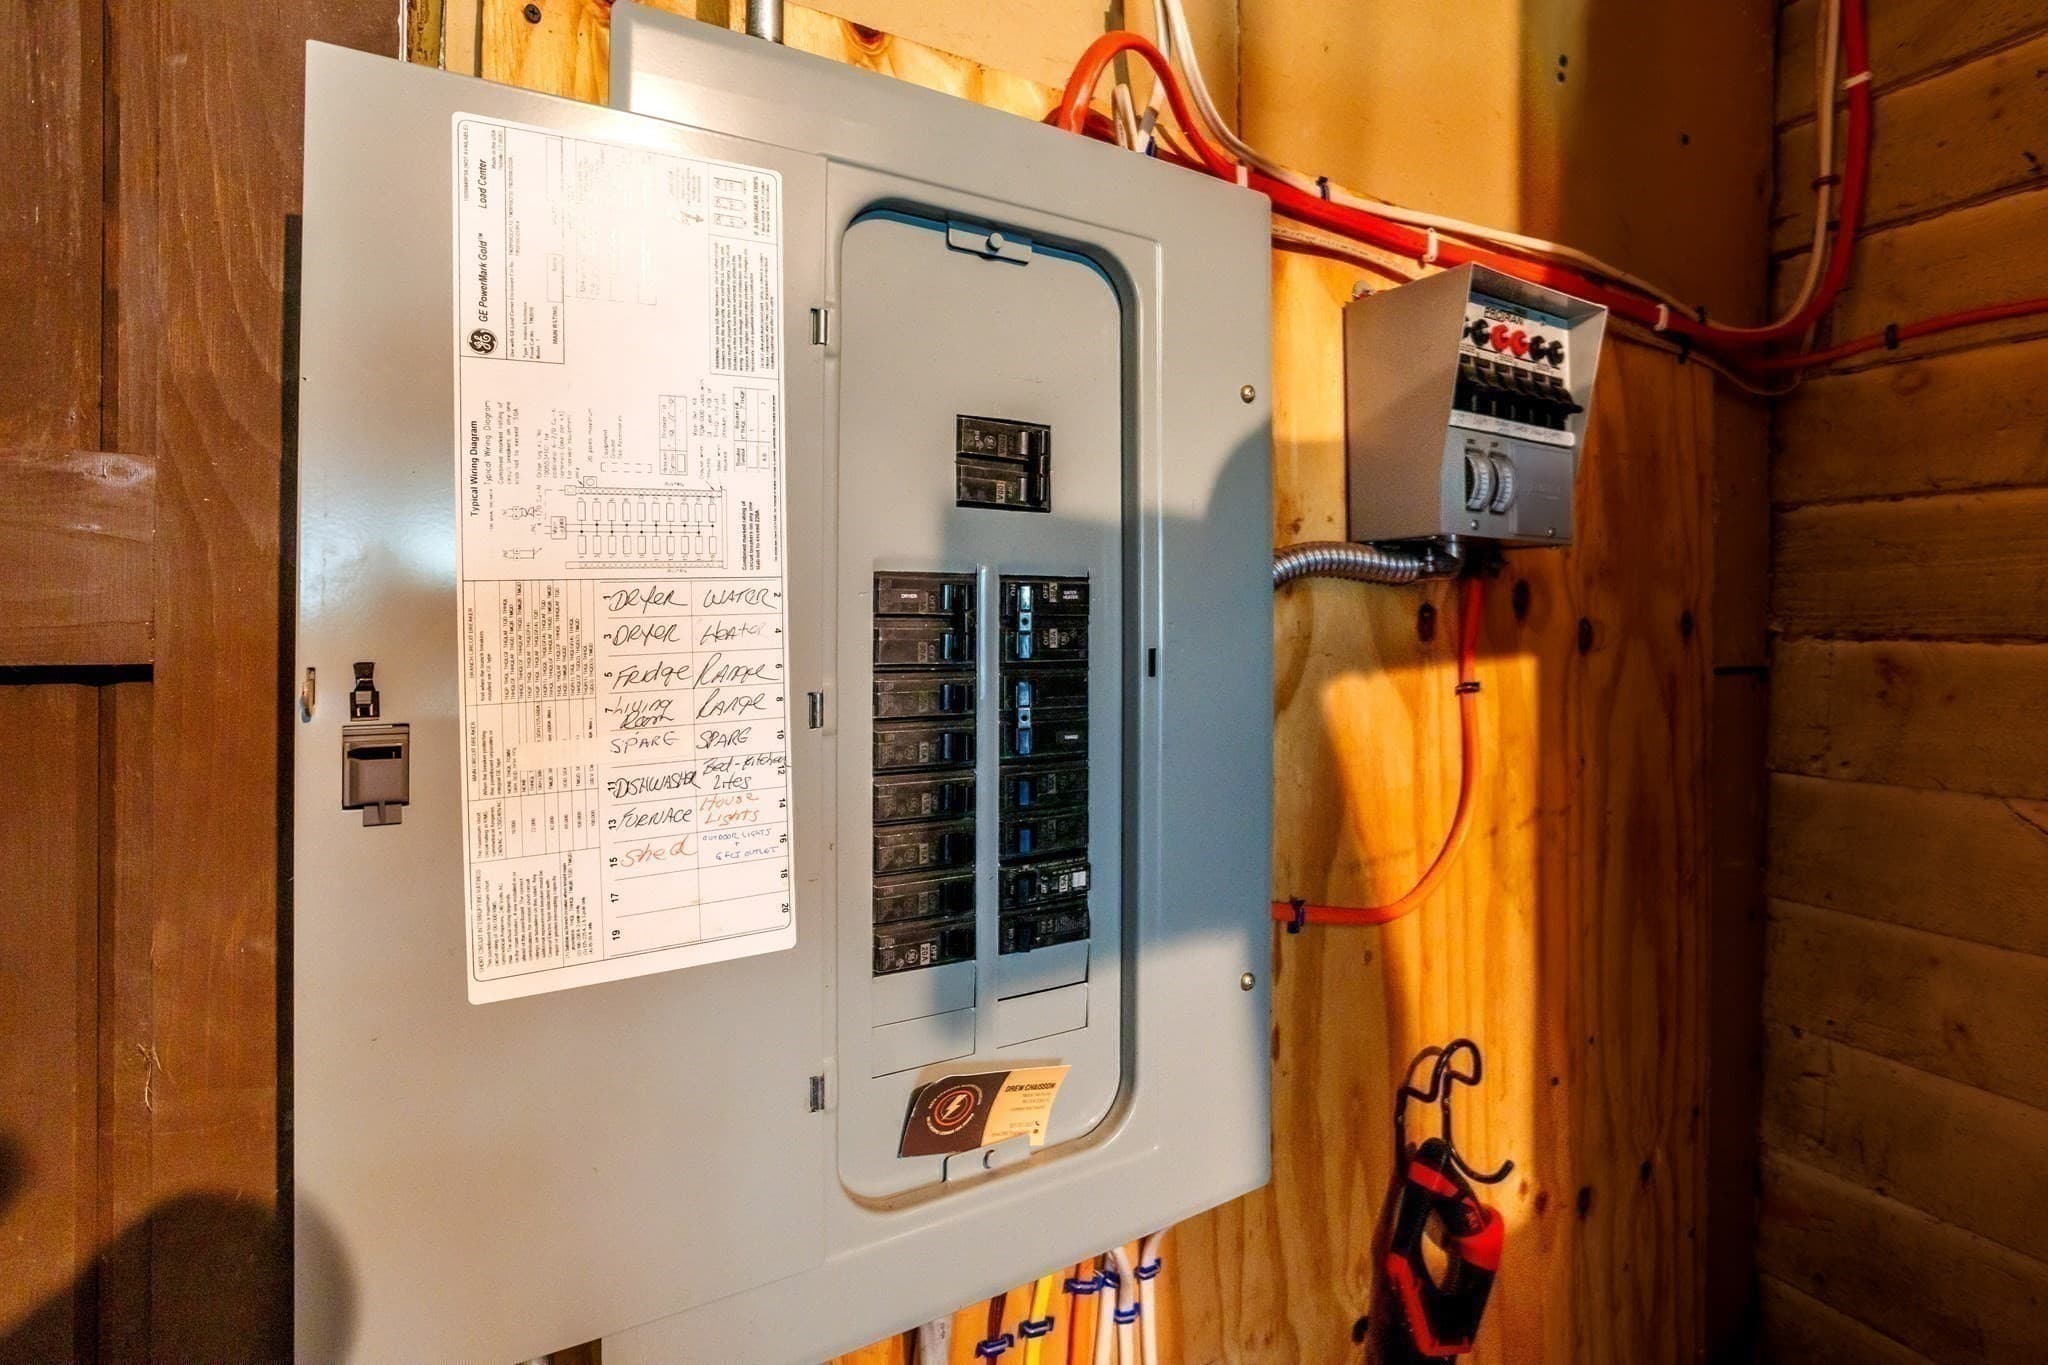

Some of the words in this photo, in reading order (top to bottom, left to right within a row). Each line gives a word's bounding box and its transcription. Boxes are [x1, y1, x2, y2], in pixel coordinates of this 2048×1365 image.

[478, 159, 486, 185] Center
[478, 187, 486, 208] Load
[478, 263, 487, 308] PowerMark
[479, 310, 488, 322] GE
[483, 400, 492, 431] Diagram
[470, 421, 479, 455] Diagram
[483, 435, 491, 456] Wiring
[470, 458, 479, 484] Wiring
[483, 461, 493, 485] Typical
[470, 487, 480, 516] Typical
[703, 588, 777, 610] WATER
[610, 731, 680, 754] SPARE
[696, 726, 752, 749] SPARE
[777, 730, 784, 740] 10
[778, 765, 786, 776] 12
[608, 781, 616, 791] 11
[779, 798, 786, 808] 14
[608, 819, 617, 830] 13
[779, 833, 787, 843] 16
[609, 857, 618, 867] 15
[780, 869, 788, 879] 18
[610, 893, 619, 903] 17
[781, 903, 789, 913] 20
[612, 930, 621, 941] 19
[921, 945, 929, 963] 20A
